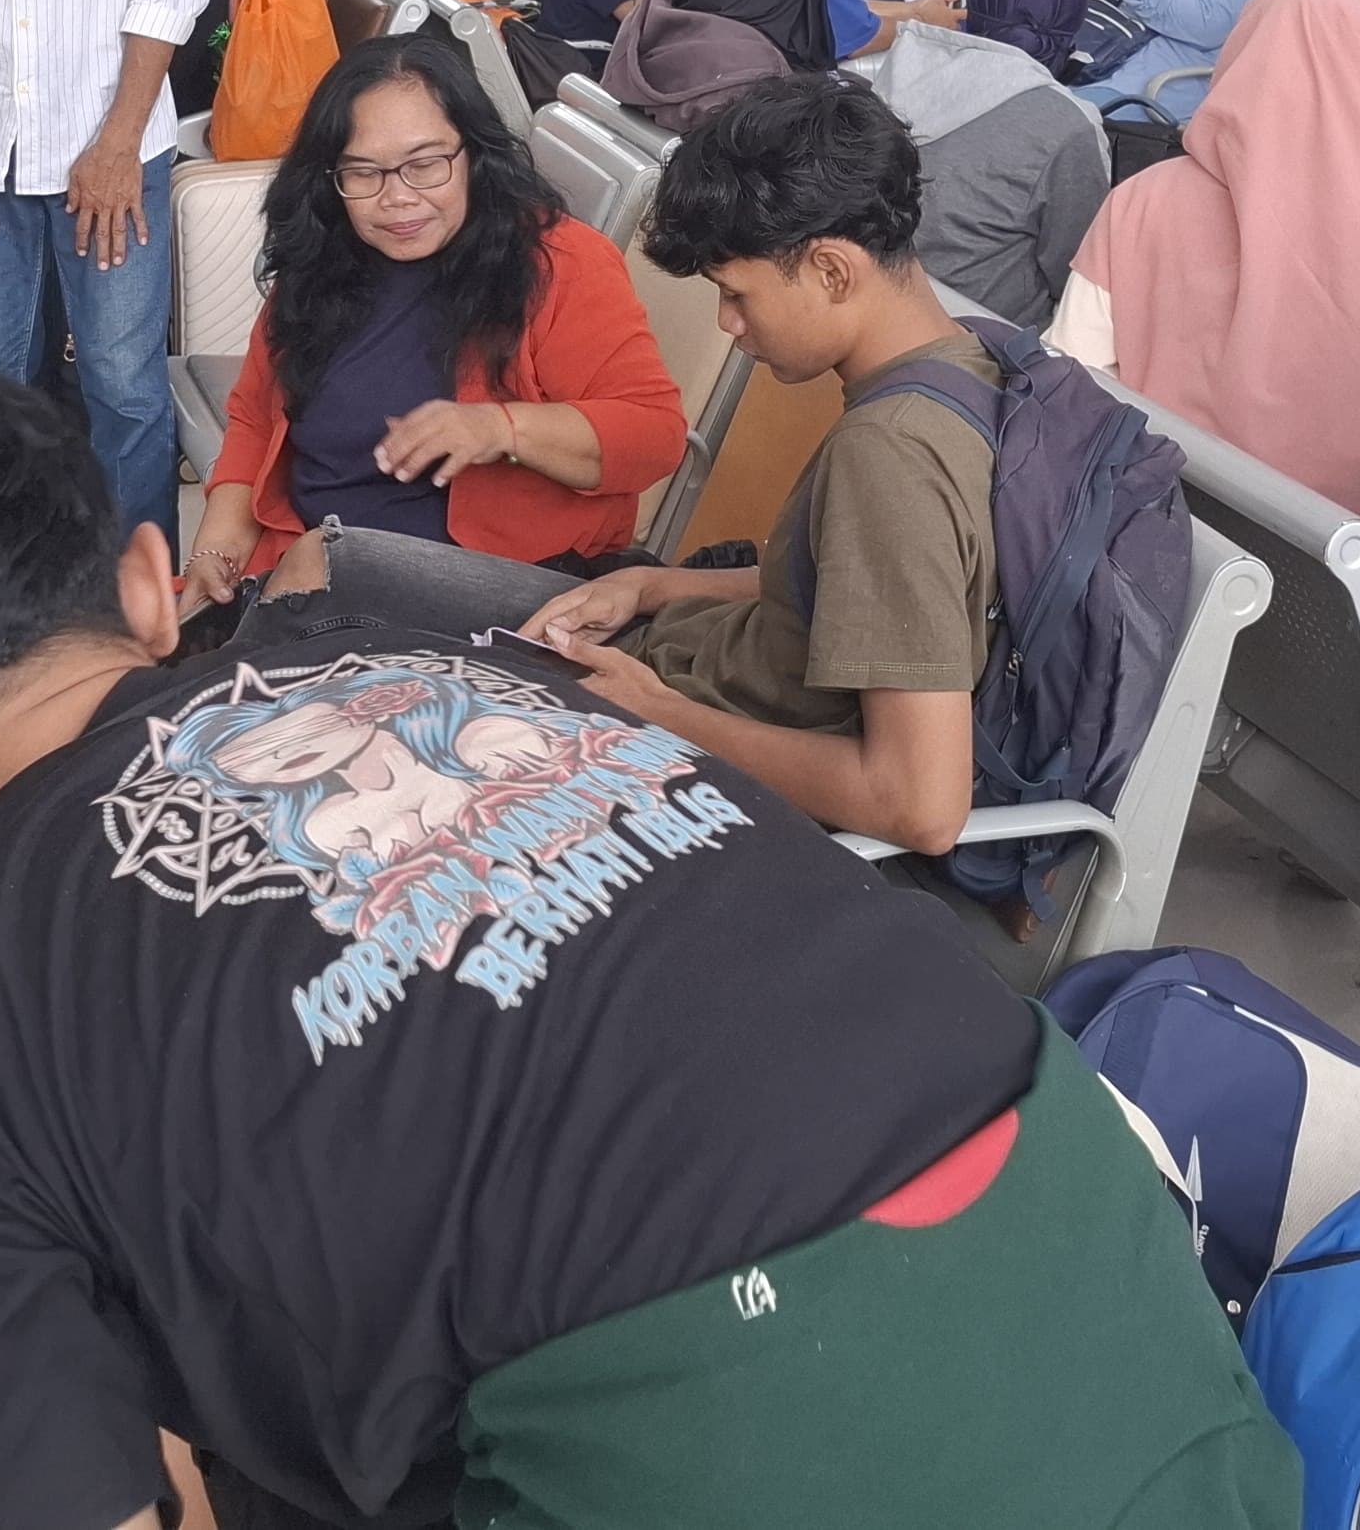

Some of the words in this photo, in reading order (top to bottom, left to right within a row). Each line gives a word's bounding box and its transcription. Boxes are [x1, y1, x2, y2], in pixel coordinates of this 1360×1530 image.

[292, 858, 496, 1067] KORBAN
[455, 826, 654, 1011] BERHATI
[618, 781, 756, 861] IBLIS
